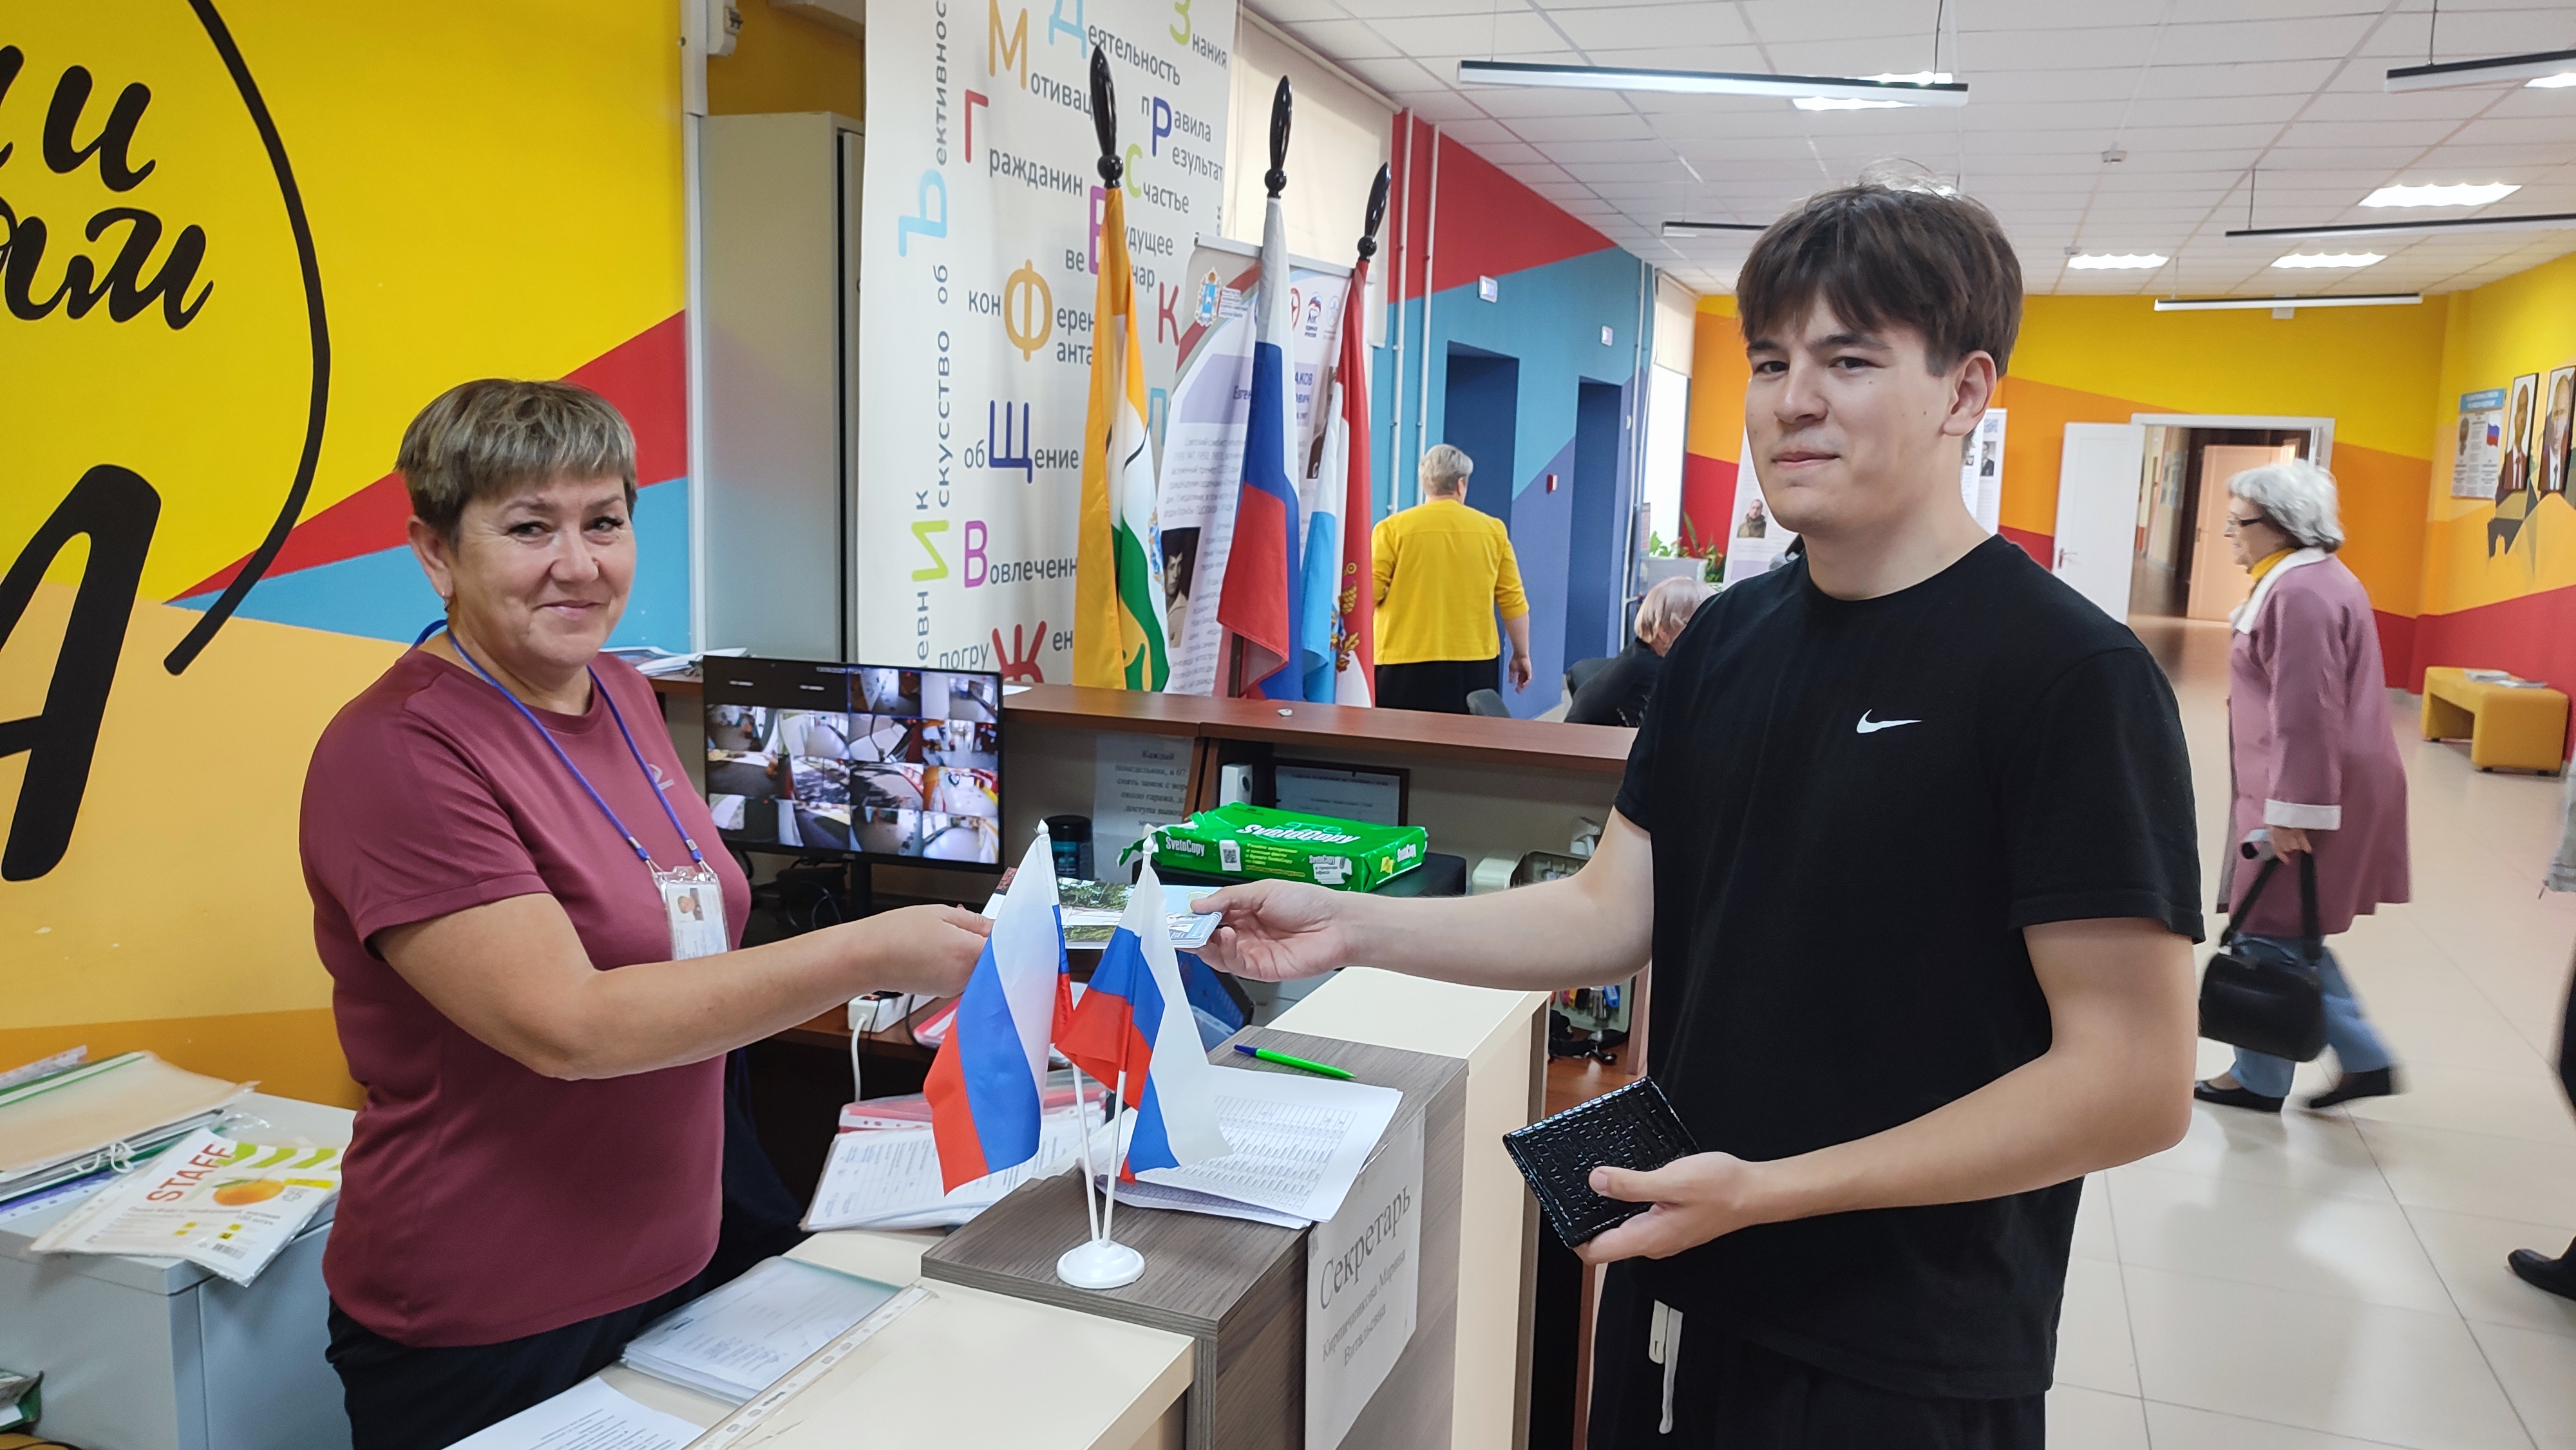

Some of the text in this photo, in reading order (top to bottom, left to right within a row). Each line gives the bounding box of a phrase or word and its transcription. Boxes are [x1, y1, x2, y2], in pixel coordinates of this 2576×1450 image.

[989, 0, 1094, 121] Мотивац
[965, 520, 1078, 588] Вовлеченн
[940, 620, 1074, 684] погруЖен
[1165, 836, 1205, 857] SvetoCopy
[1235, 824, 1361, 844] SvetoCopy
[146, 1143, 232, 1203] STAFF
[1320, 1185, 1411, 1311] Секретарь
